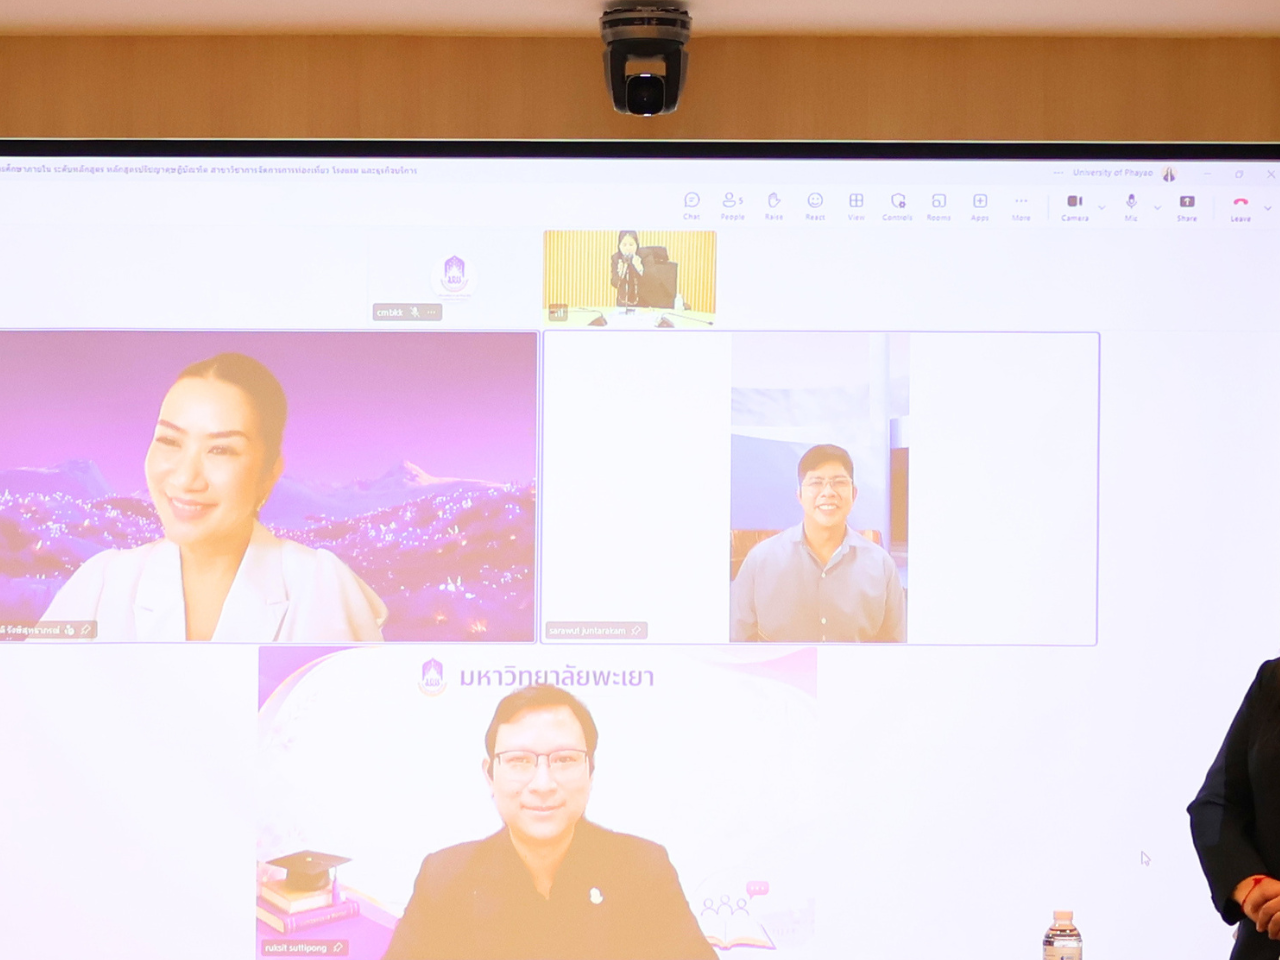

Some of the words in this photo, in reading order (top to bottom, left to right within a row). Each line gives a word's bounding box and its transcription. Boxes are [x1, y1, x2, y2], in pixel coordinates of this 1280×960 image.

[1073, 168, 1110, 179] University
[1113, 169, 1122, 177] of
[1125, 168, 1153, 179] Phayao
[721, 213, 745, 222] People
[806, 213, 825, 221] React
[848, 213, 865, 221] View
[882, 213, 912, 221] Controls
[971, 214, 989, 223] Apps
[1012, 214, 1030, 222] More
[1061, 214, 1089, 222] Camera
[1125, 214, 1138, 222] Mic
[1177, 214, 1197, 222] Share
[1231, 215, 1251, 223] Leave
[549, 626, 580, 635] sarawut
[460, 664, 654, 687] มหาวิทยาลัยพะเยา
[265, 943, 287, 952] ruksit
[289, 943, 327, 954] suttipong
